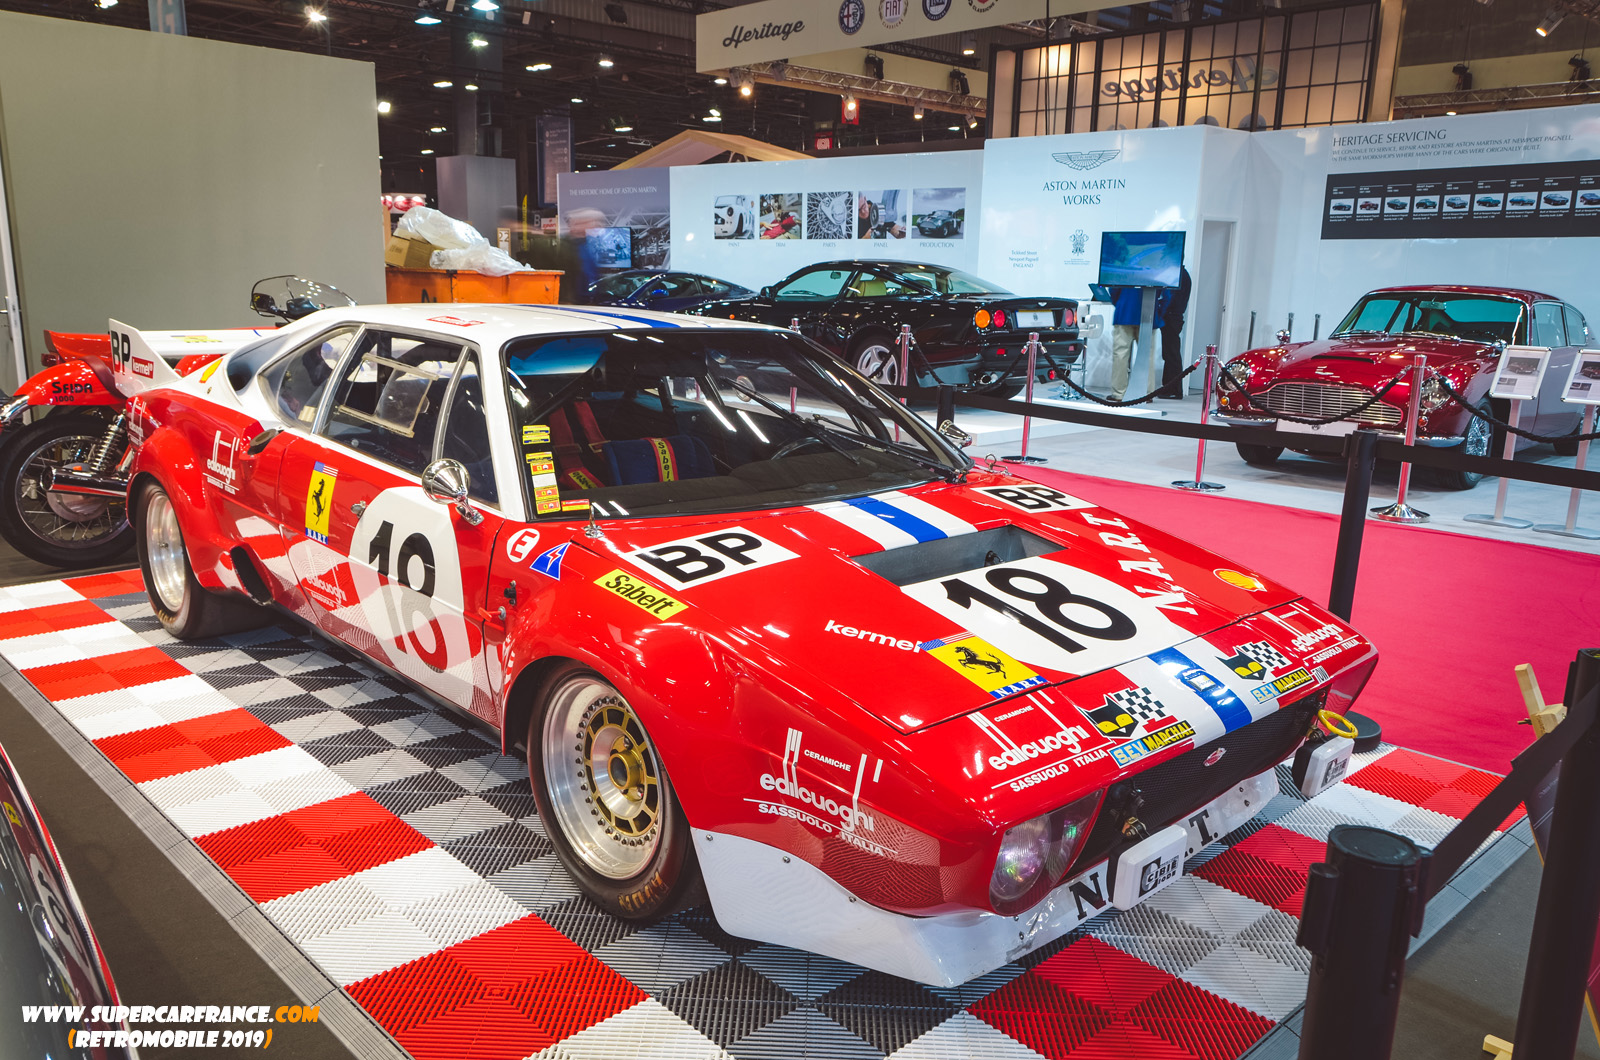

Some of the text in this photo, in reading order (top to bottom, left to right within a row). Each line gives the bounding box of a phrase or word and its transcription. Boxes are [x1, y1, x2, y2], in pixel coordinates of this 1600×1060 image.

[722, 20, 805, 48] Heritage
[1333, 129, 1447, 147] HERITAGE SERVICING
[1486, 145, 1521, 153] ORIGINALLY
[1512, 136, 1543, 144] NEWPORT
[600, 187, 613, 195] HOME
[622, 186, 637, 194] ASTON
[638, 185, 657, 193] MARTIN
[1043, 179, 1126, 192] ASTON MARTIN
[1063, 194, 1101, 206] WORKS
[658, 441, 671, 481] Sabel
[983, 484, 1071, 508] BP
[635, 532, 763, 583] BP
[605, 574, 674, 614] Sabelt
[940, 567, 1138, 654] 18
[824, 619, 922, 654] kermel
[993, 705, 1034, 723] CERAMICHE
[1142, 722, 1195, 752] MARCHAL
[804, 749, 852, 772] CERAMICHE
[1010, 749, 1109, 792] SASSUOLO ITALIA
[758, 803, 885, 857] SASSUOLO ITALIA
